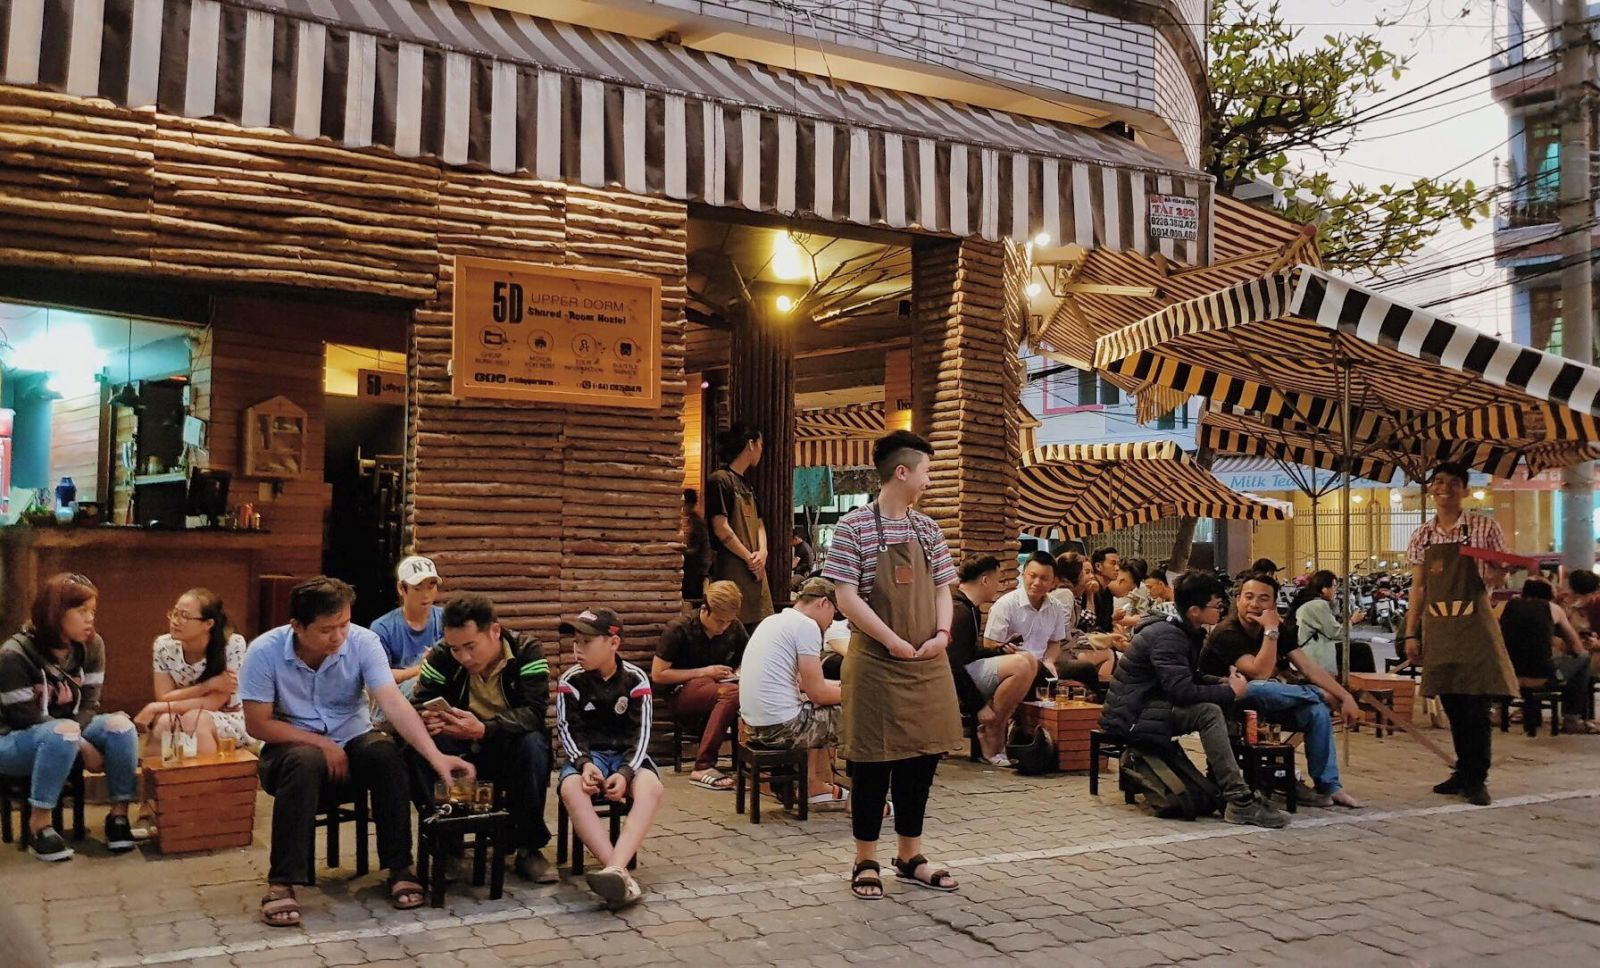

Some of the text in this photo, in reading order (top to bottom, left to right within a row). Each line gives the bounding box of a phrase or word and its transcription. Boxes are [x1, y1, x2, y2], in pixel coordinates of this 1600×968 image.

[493, 281, 524, 324] 5D
[531, 292, 625, 313] UPPER DORM
[527, 306, 562, 319] Shared
[597, 314, 627, 325] Hostel
[1231, 474, 1266, 489] Milk
[411, 561, 432, 574] NY
